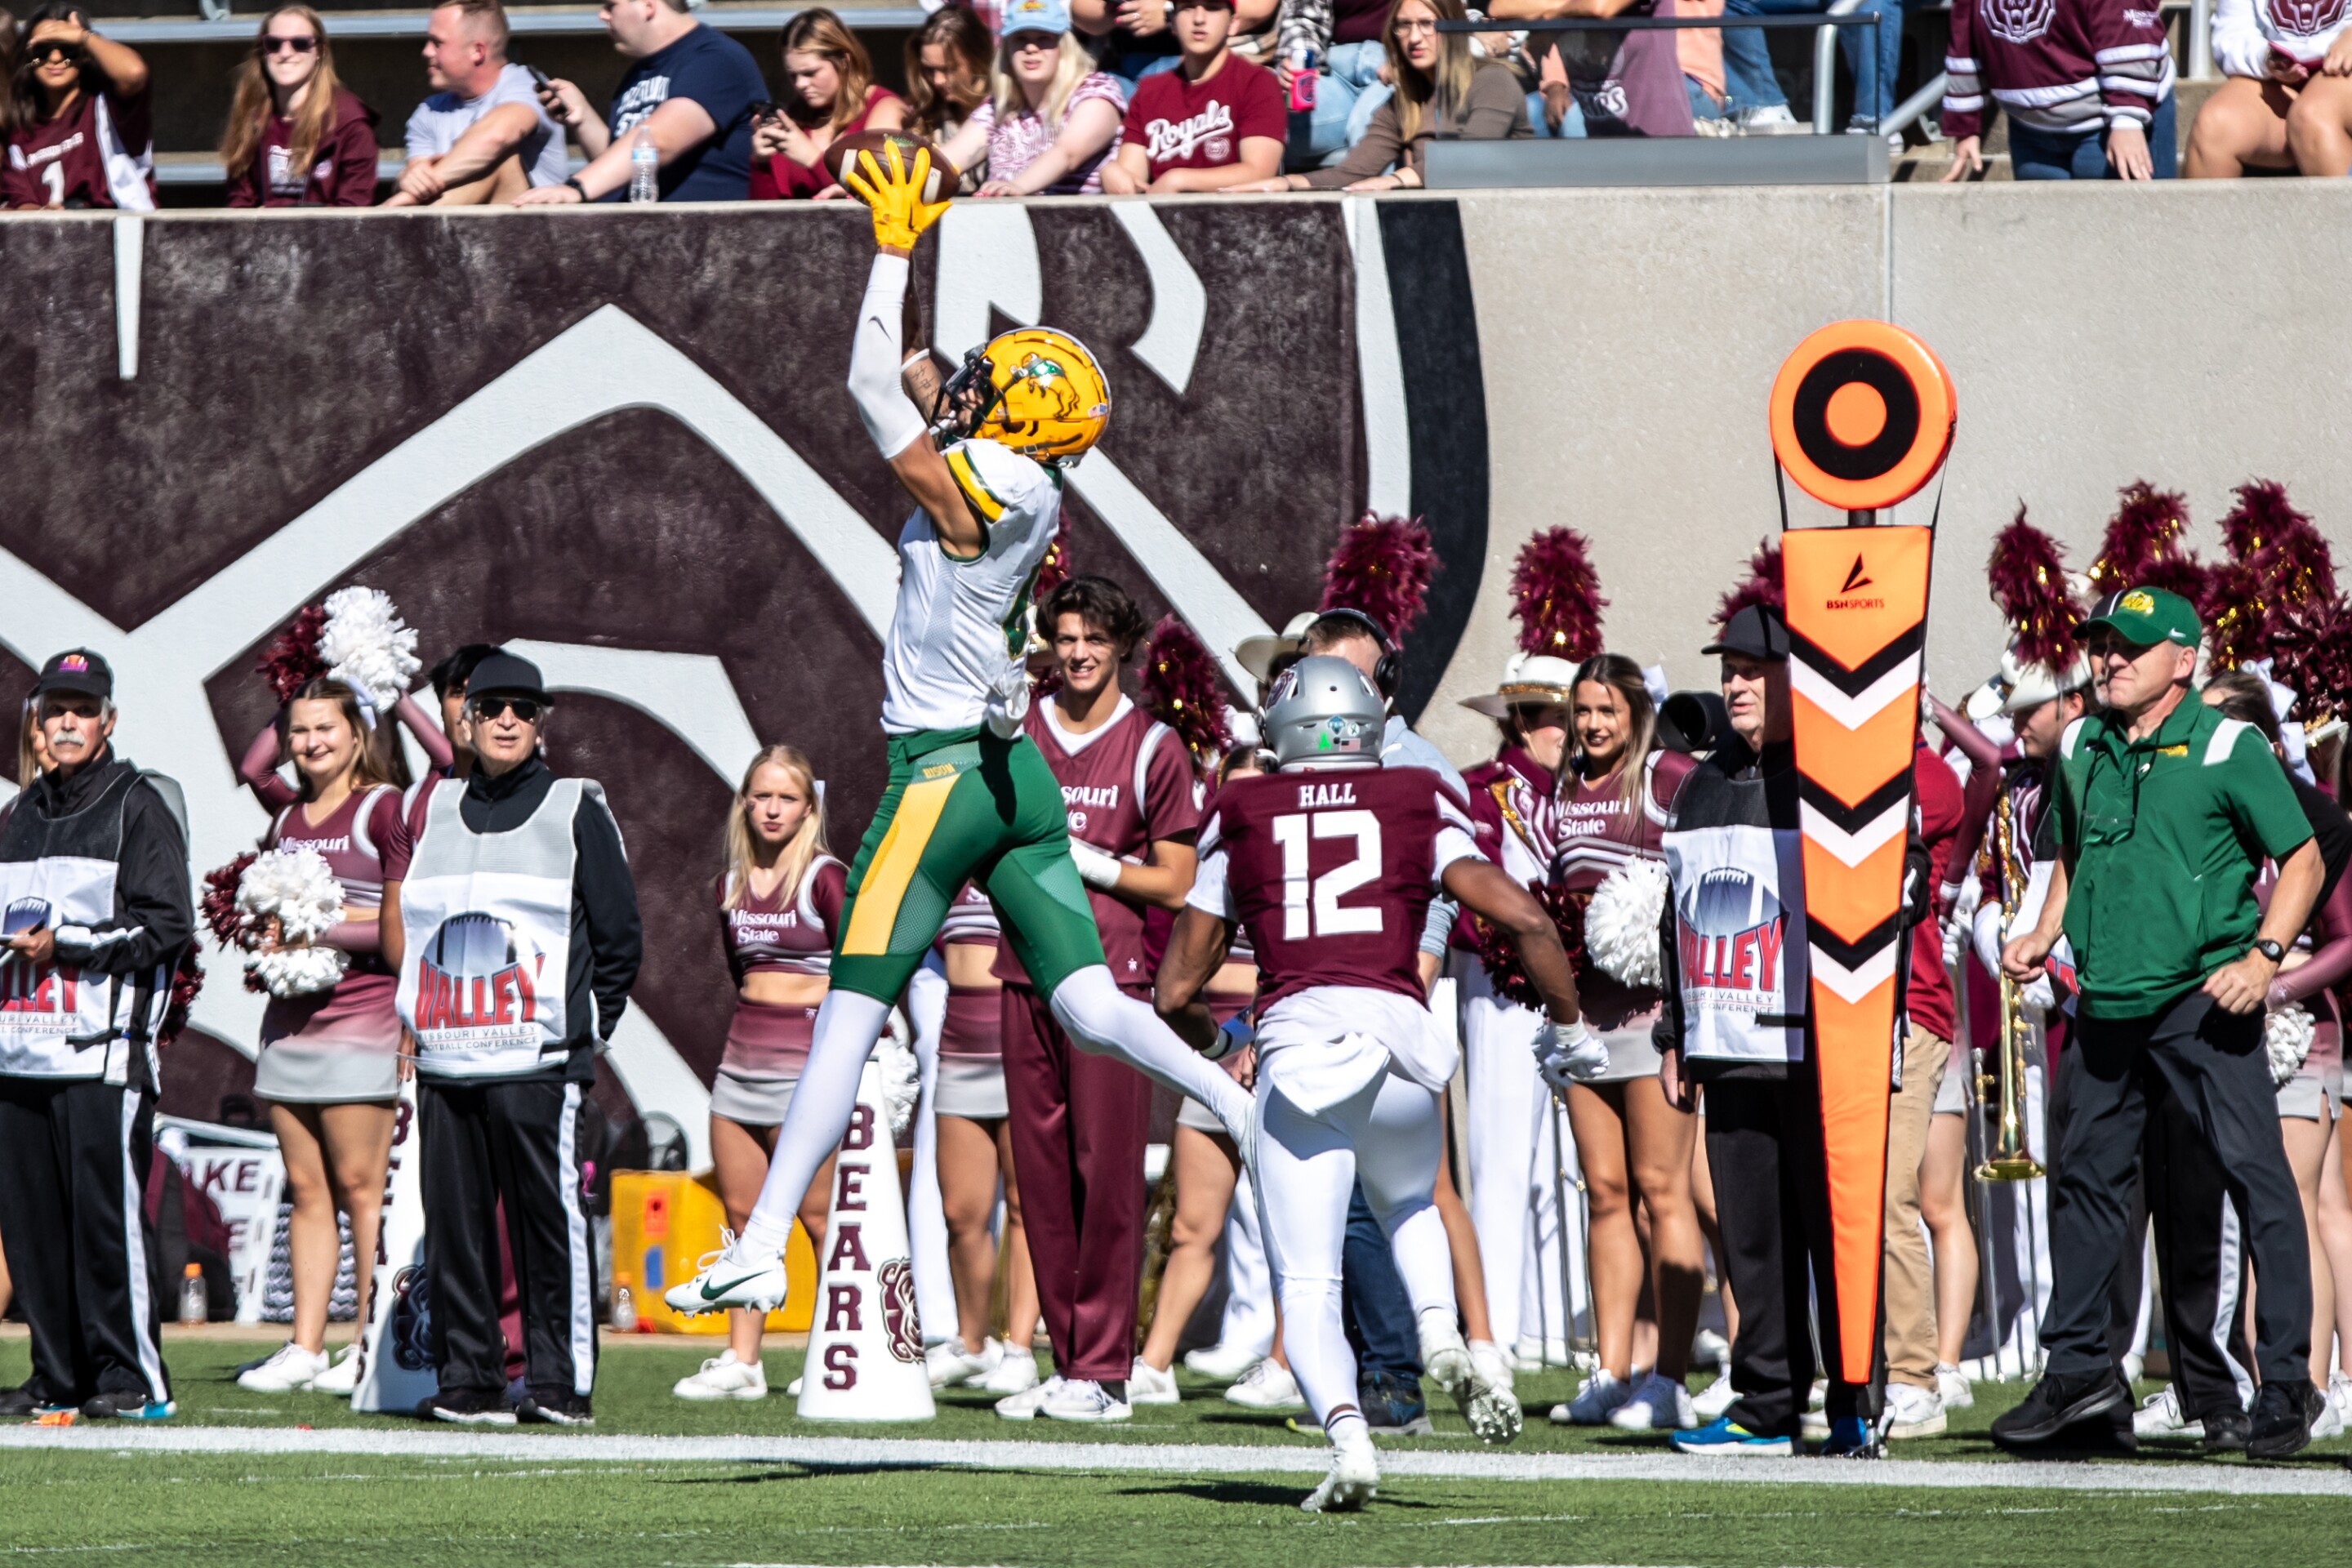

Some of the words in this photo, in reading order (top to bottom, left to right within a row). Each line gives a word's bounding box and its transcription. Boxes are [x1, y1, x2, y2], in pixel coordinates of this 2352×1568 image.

[1144, 99, 1232, 161] Royals
[922, 762, 956, 778] BISON
[1061, 785, 1119, 808] souri
[1299, 782, 1356, 808] HALL
[1557, 817, 1606, 840] State
[1272, 809, 1383, 941] 12
[728, 908, 797, 928] Missouri
[737, 926, 780, 945] State
[414, 951, 546, 1031] VALLEY
[1718, 991, 1774, 1004] VALLEY
[482, 1024, 537, 1037] VALLEY
[466, 1036, 539, 1049] CONFERENCE
[822, 1102, 875, 1391] BEARS
